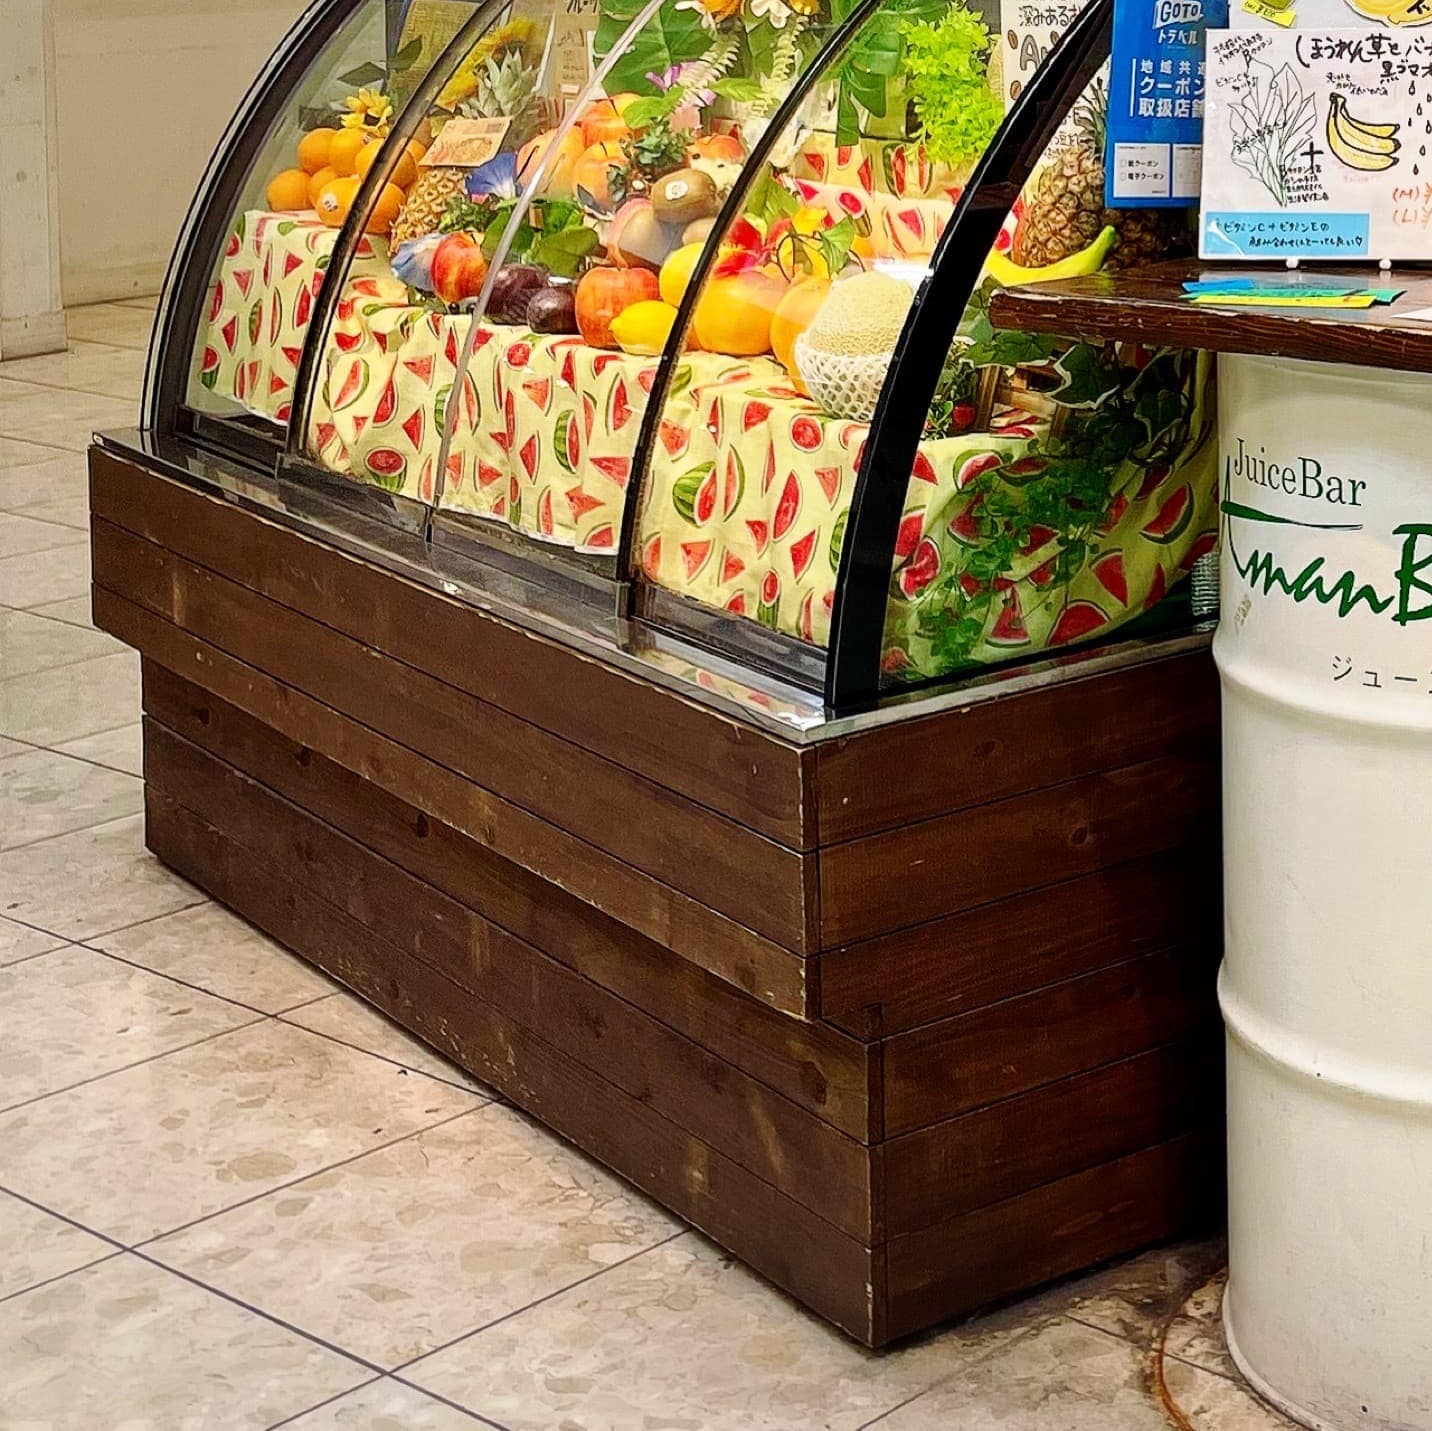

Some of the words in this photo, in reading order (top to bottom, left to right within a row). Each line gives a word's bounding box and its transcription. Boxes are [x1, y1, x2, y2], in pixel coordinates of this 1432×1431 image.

[1158, 28, 1199, 45] トラベル
[1234, 437, 1367, 506] JuiceBar
